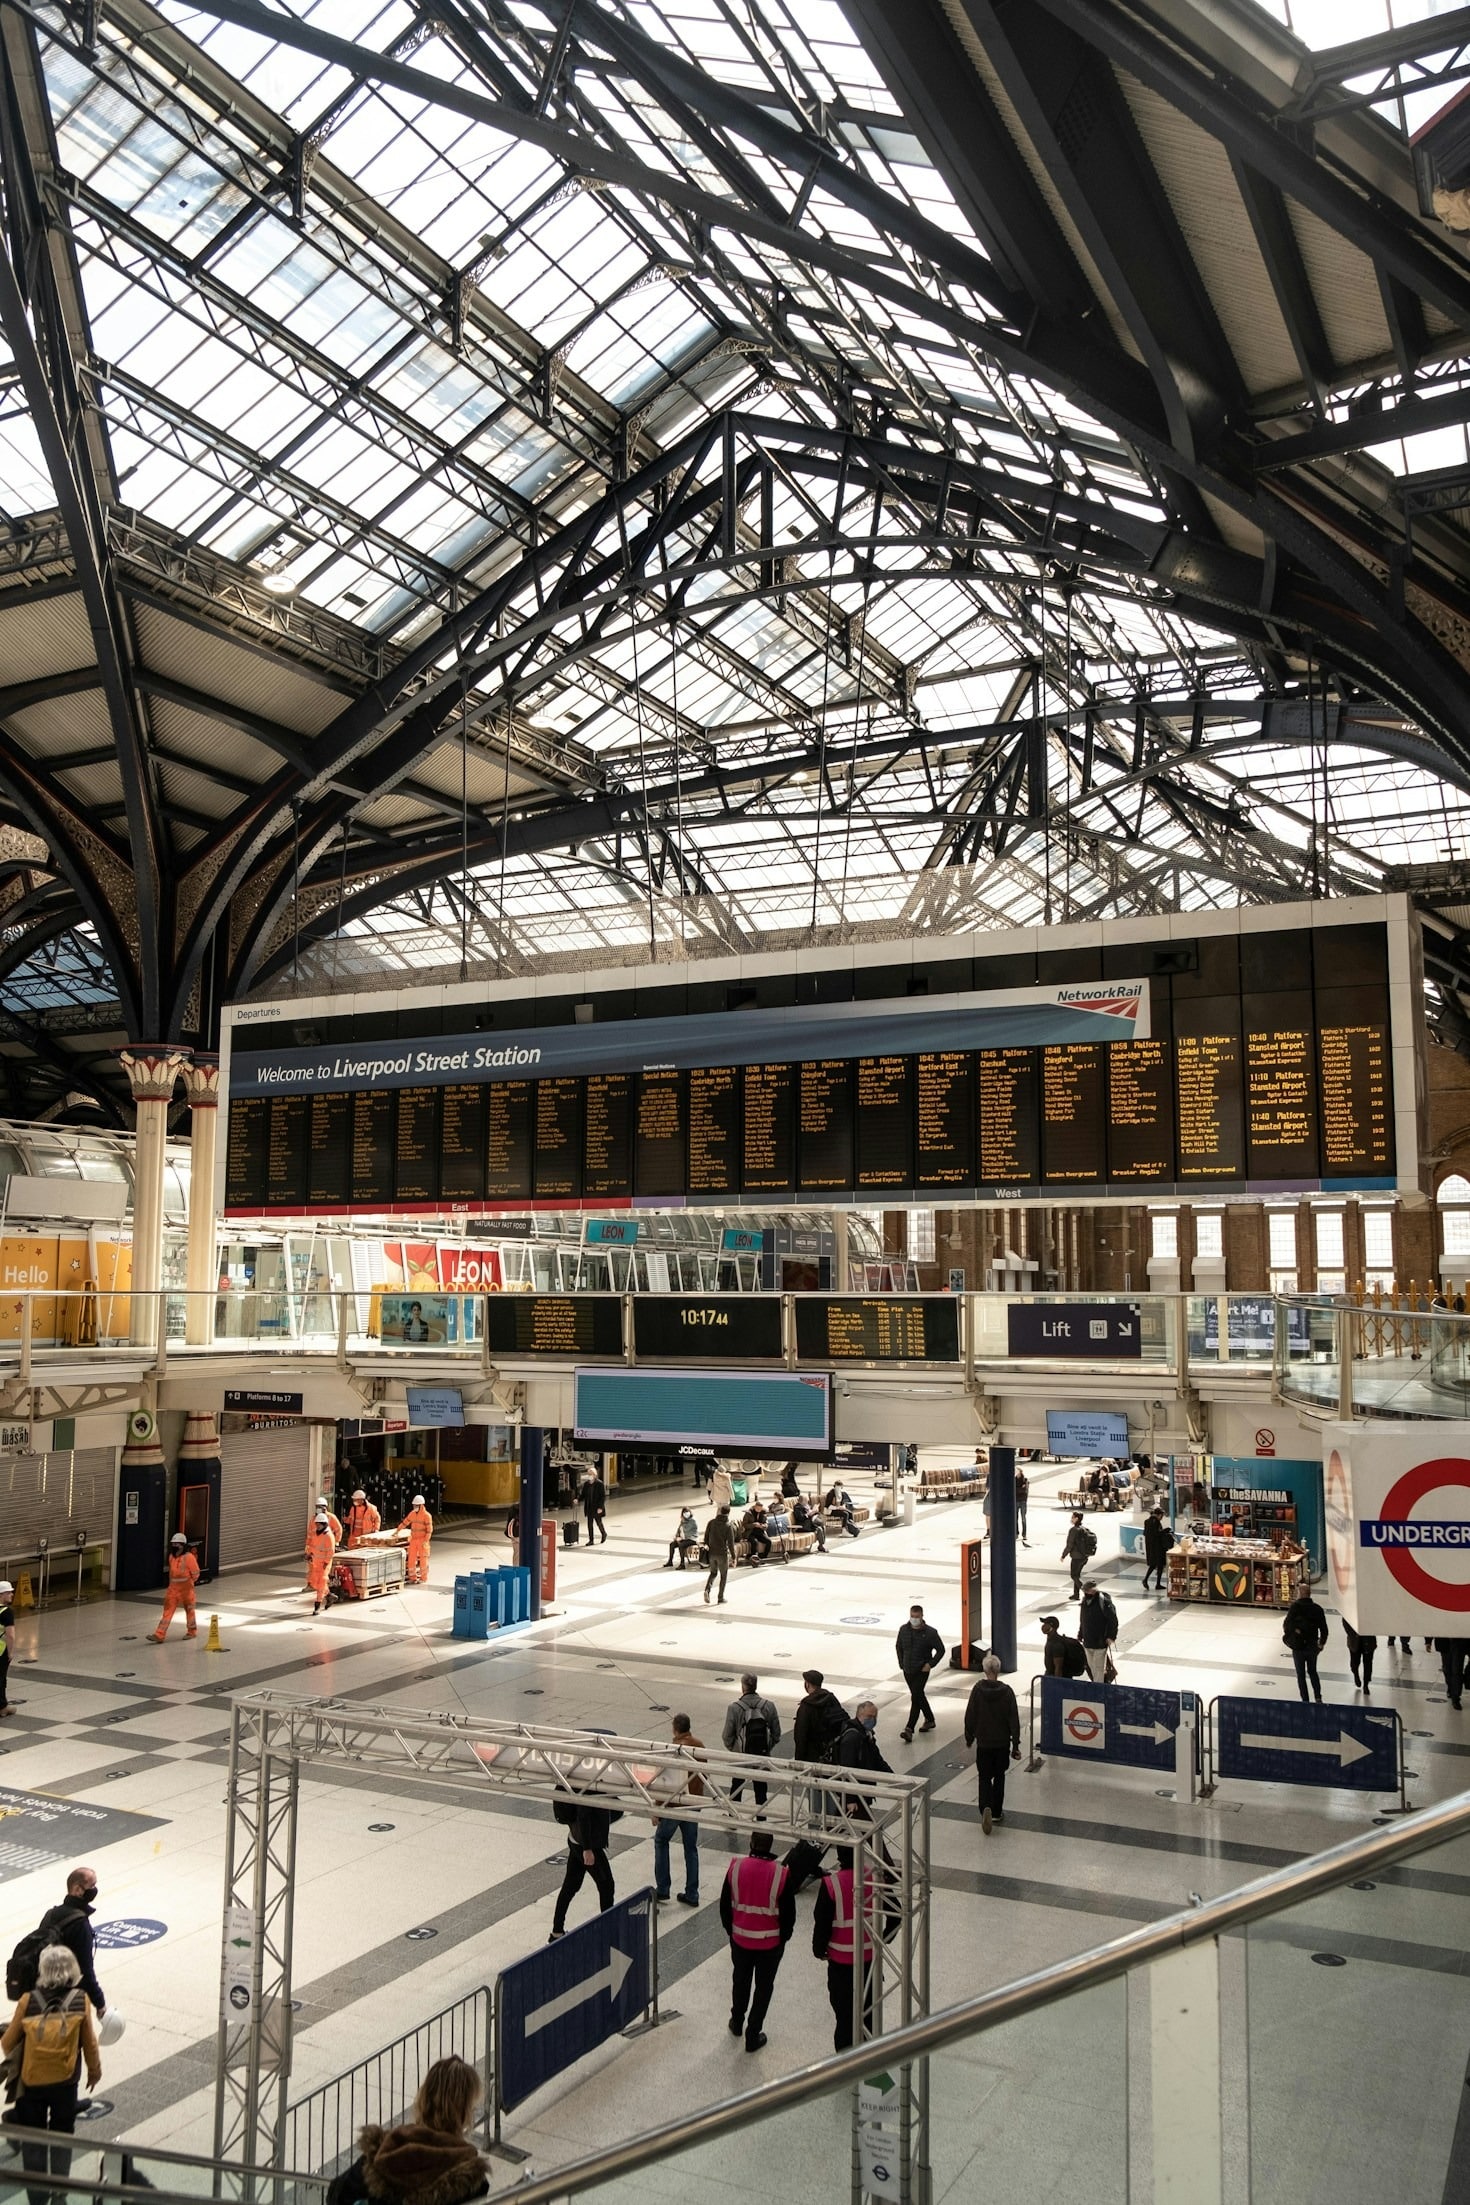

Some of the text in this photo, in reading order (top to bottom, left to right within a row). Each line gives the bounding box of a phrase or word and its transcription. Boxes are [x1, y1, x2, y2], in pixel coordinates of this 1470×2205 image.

[237, 1008, 281, 1019] Departures
[1178, 1048, 1199, 1056] Enfield
[1248, 1041, 1305, 1052] Stansted Airport
[1044, 1056, 1072, 1064] Chingford
[1110, 1050, 1160, 1060] Cambridge North
[257, 1046, 541, 1083] Welcome to Liverpool Street Station
[1282, 1081, 1306, 1090] Airport
[1251, 1122, 1308, 1131] Stansted Airport
[995, 1189, 1022, 1198] West
[602, 1226, 624, 1239] LEON
[735, 1234, 752, 1247] LEON
[5, 1265, 49, 1284] Hello
[452, 1260, 492, 1283] LEON
[1209, 1305, 1258, 1315] Art Me!
[1042, 1321, 1071, 1337] Lift
[254, 1419, 294, 1430] BURRITOS
[2, 1428, 28, 1445] wasab
[678, 1446, 714, 1456] JCDecaux
[1229, 1489, 1287, 1502] theSAVANNA
[21, 1798, 71, 1812] tickets
[71, 1808, 108, 1820] train
[862, 2103, 900, 2112] KEEP RIGHT
